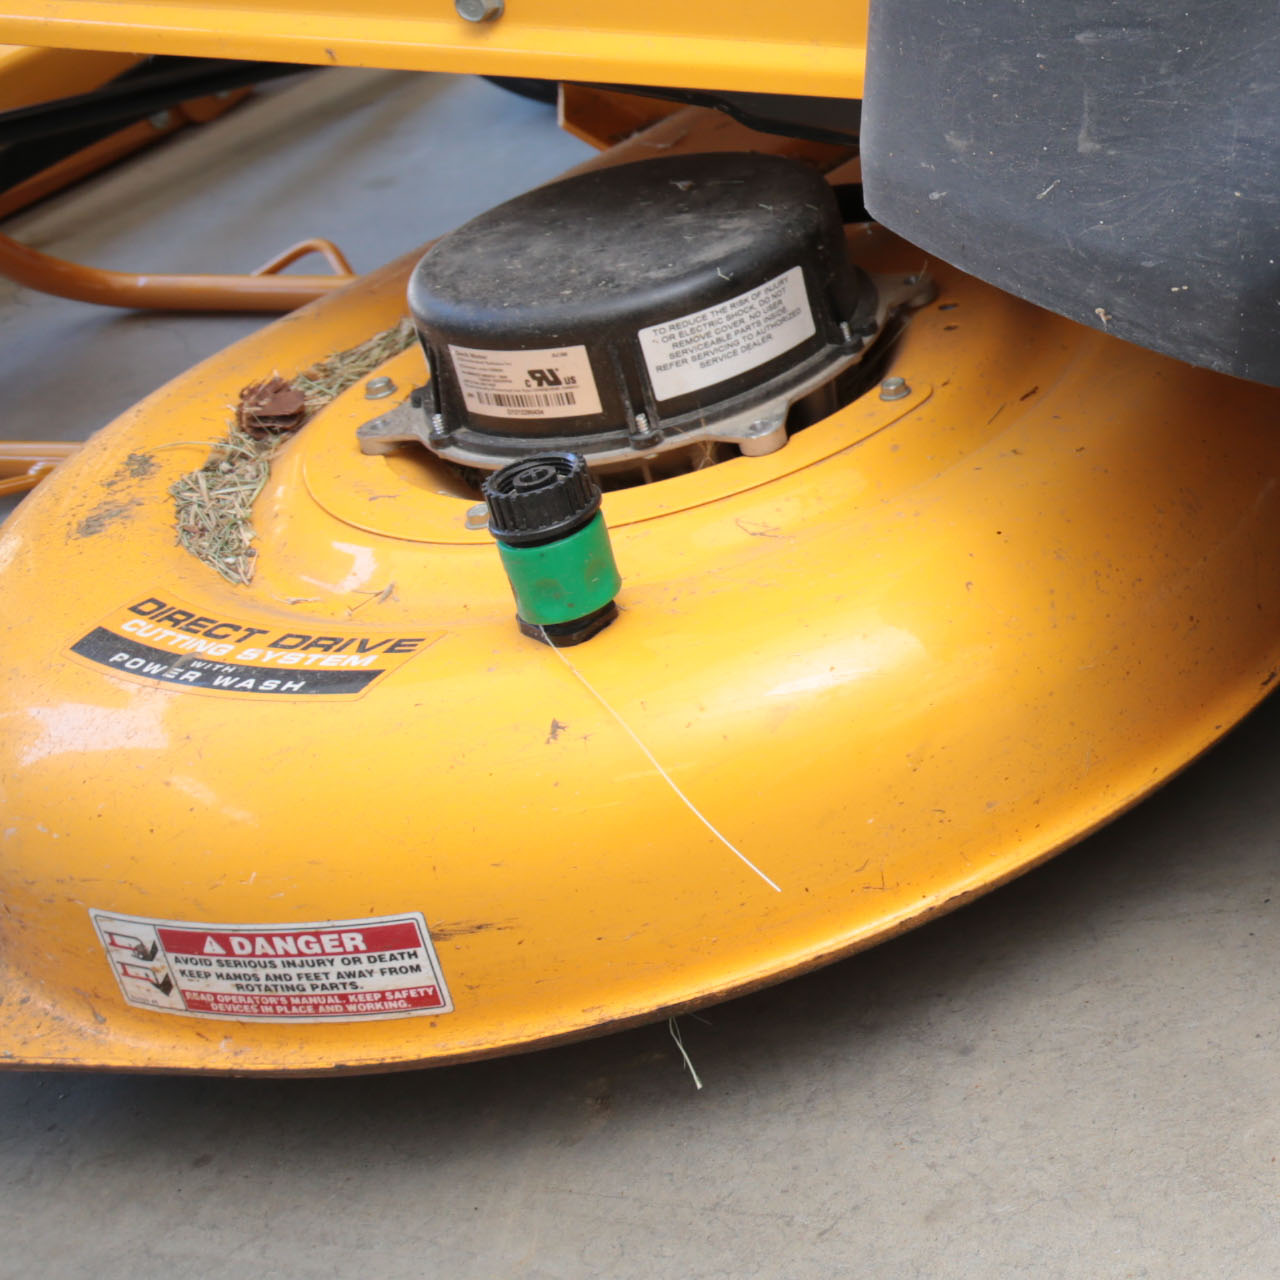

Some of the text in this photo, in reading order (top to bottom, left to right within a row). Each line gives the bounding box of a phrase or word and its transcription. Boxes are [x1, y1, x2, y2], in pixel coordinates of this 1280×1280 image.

[652, 277, 789, 337] TO REDUCE THE RISK OF INJURY
[661, 333, 677, 344] OR
[678, 318, 724, 339] ELECTRIC
[758, 297, 771, 307] DO
[771, 287, 786, 300] NOT
[672, 332, 713, 350] REMOVE
[750, 310, 762, 321] NO
[763, 299, 783, 314] USER
[656, 308, 802, 373] REFER SERVICING TO AUTHORIZED
[669, 332, 732, 360] SERVICEABLE
[734, 319, 762, 338] PARTS
[700, 350, 739, 369] SERVICE
[564, 376, 577, 385] US
[128, 597, 427, 654] DIRECT DRIVE
[121, 619, 379, 669] CUTTING SYSTEM
[110, 652, 306, 692] POWER WASH
[190, 659, 237, 673] WITH
[229, 932, 367, 955] DANGER
[174, 950, 418, 969] AVOID SERIOUS INJURY OR DEATH
[179, 964, 422, 982] KEEP HANDS AND FEET AWAY FROM
[185, 991, 214, 1002] READ
[217, 994, 289, 1005] OPERATOR'S
[349, 993, 381, 1003] KEEP
[385, 987, 434, 1001] SAFETY
[236, 981, 364, 993] ROTATING PARTS.
[211, 1003, 258, 1013] DEVICES
[277, 1005, 313, 1014] PLACE
[319, 1004, 344, 1013] AND
[345, 1000, 412, 1012] WORKING.
